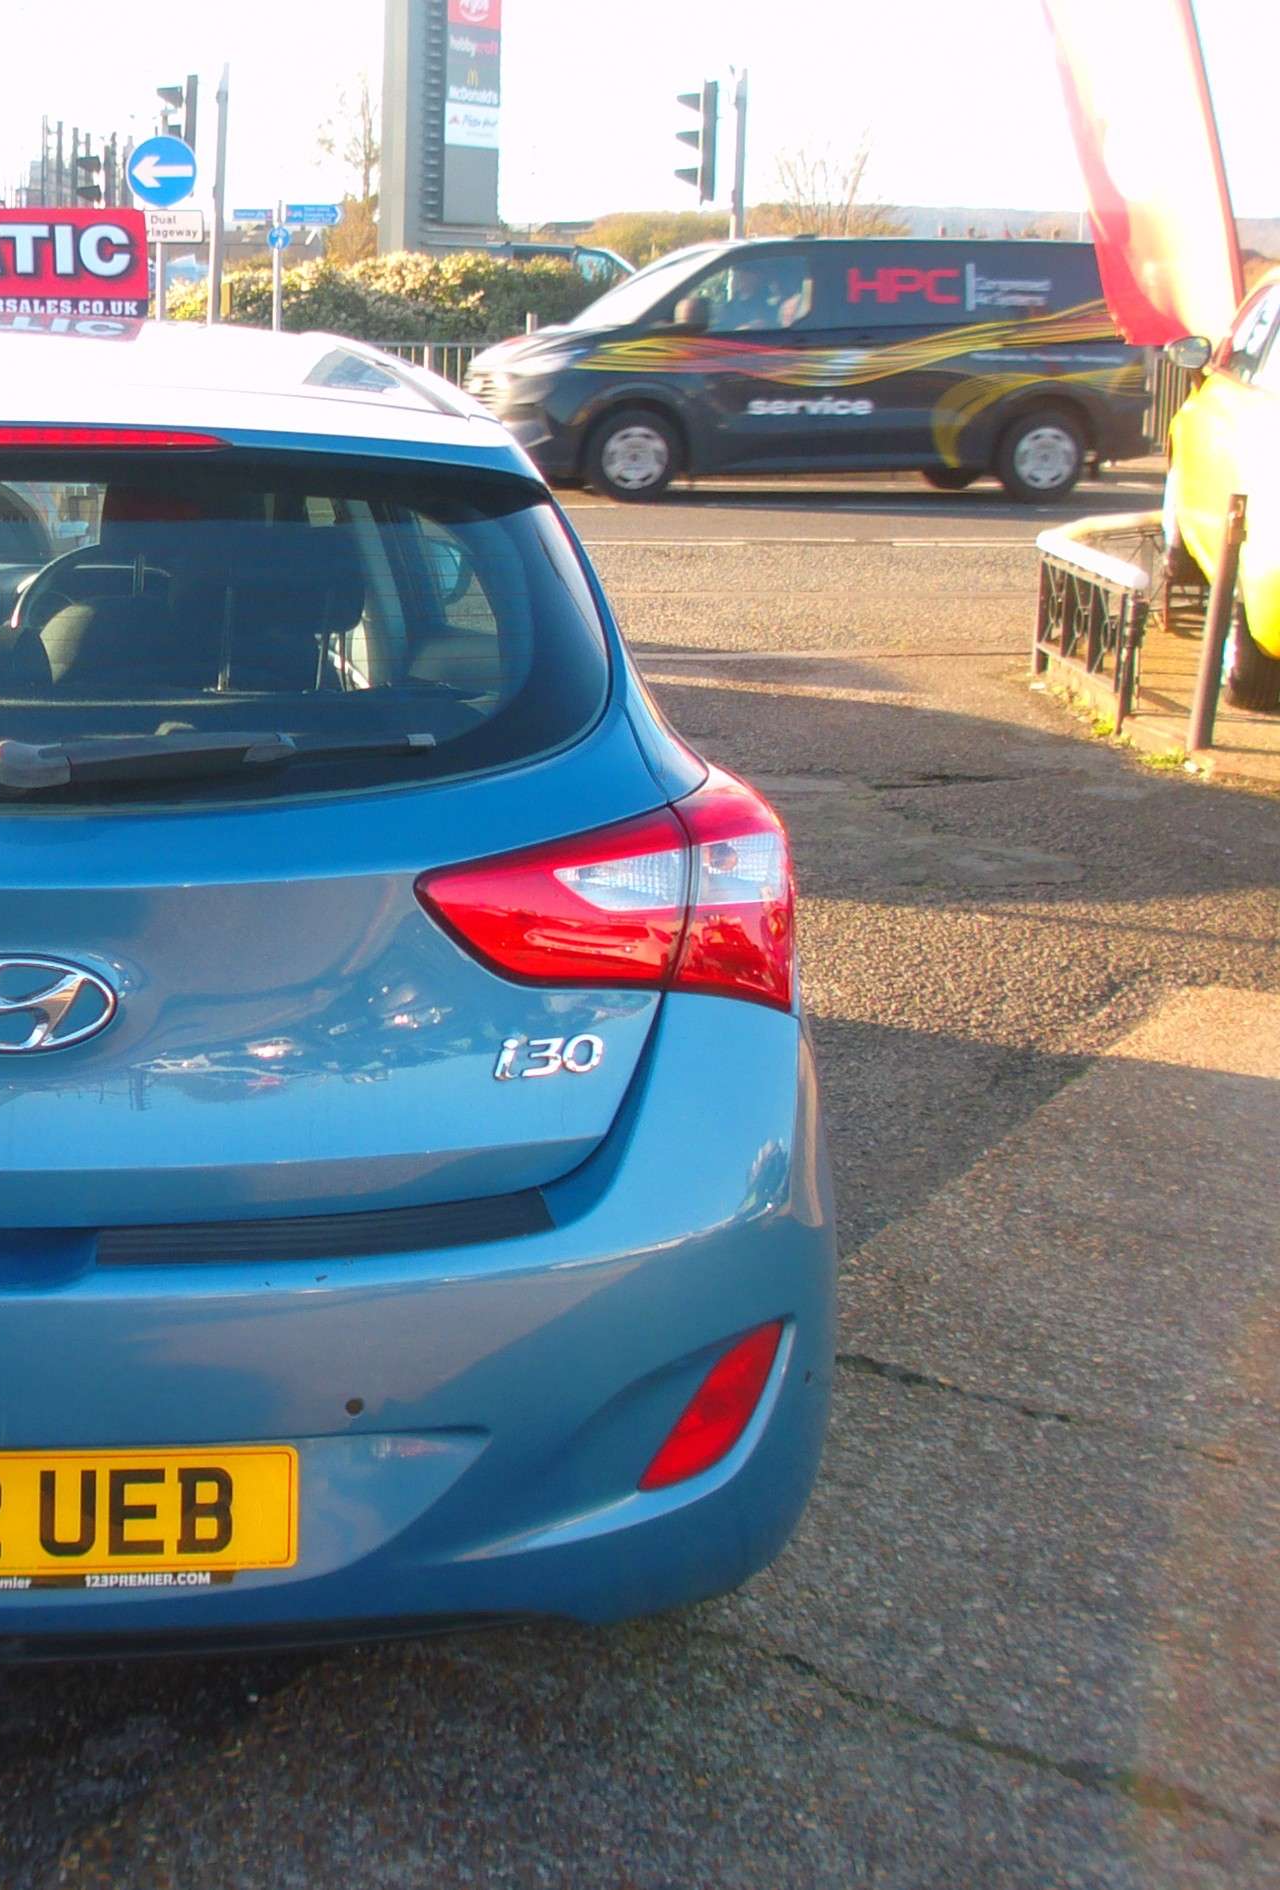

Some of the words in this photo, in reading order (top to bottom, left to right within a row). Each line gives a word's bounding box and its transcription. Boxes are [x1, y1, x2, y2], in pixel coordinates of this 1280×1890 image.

[150, 215, 177, 225] Dual
[847, 267, 961, 304] HPC
[746, 396, 874, 416] service
[494, 1033, 604, 1080] i30
[39, 1466, 233, 1557] UEB
[84, 1572, 211, 1588] 123PREMIER.COM
